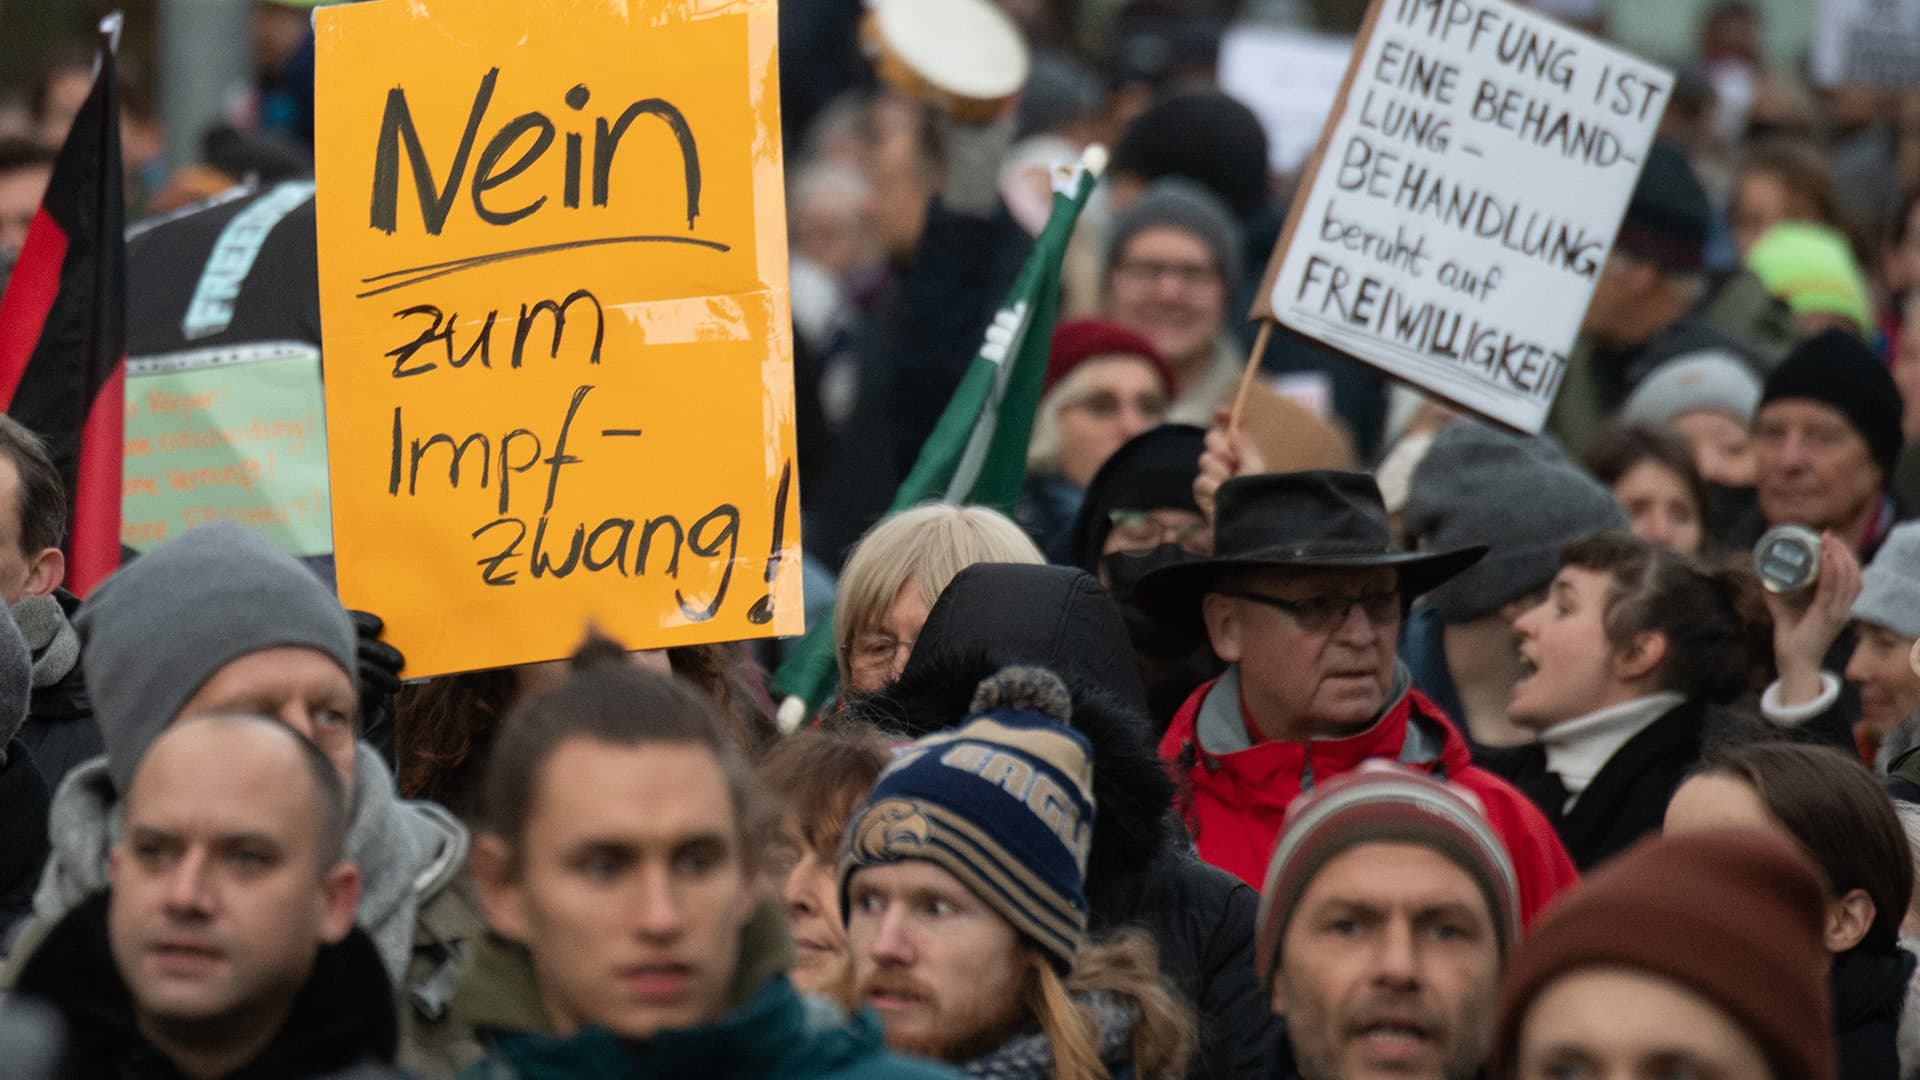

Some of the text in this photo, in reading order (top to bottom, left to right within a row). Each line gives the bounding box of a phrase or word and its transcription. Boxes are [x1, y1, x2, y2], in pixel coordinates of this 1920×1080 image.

[1375, 40, 1637, 169] EINE BEHAND-
[1395, 0, 1662, 122] IMPFUNG IST
[369, 66, 701, 235] Nein
[1336, 136, 1603, 283] BEHANDLUNG
[1319, 200, 1503, 302] beruht auf
[385, 289, 605, 378] zum
[1296, 255, 1567, 400] FREIWILLIGKEIT
[389, 385, 642, 514] Impf-
[471, 457, 792, 625] zwang!
